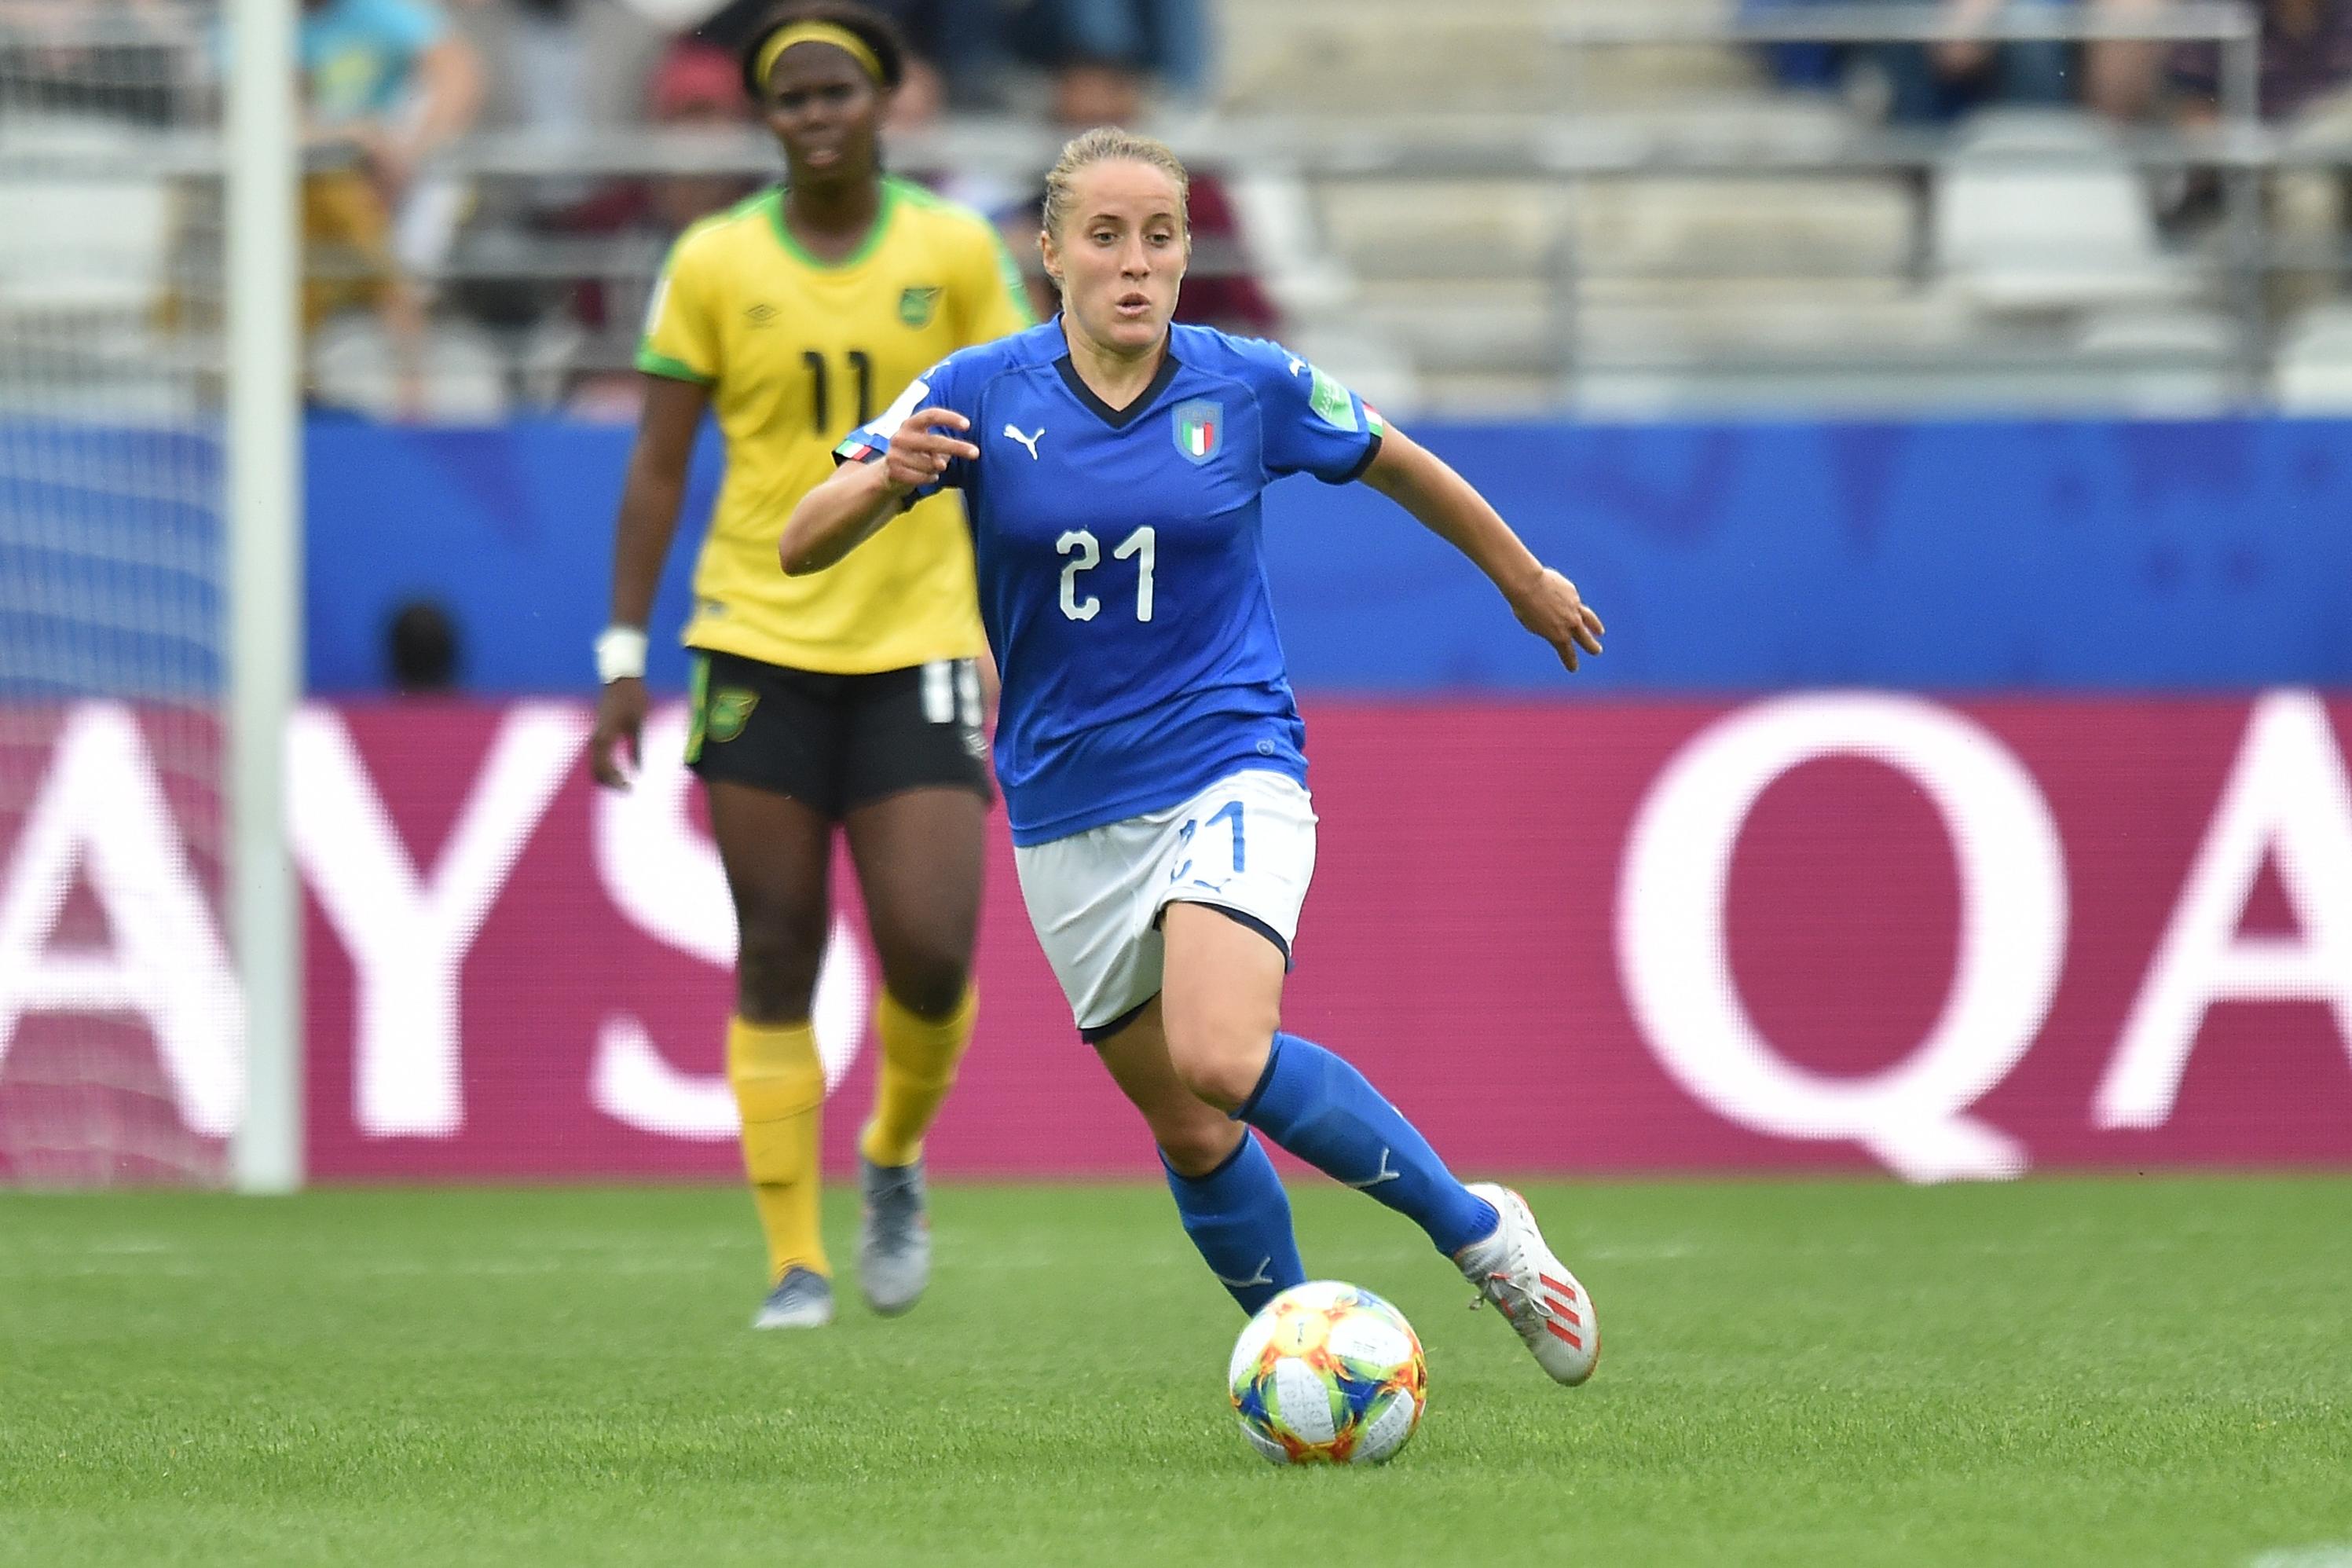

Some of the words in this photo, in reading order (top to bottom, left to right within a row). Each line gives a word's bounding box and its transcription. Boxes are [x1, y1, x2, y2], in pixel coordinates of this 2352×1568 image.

[801, 350, 872, 436] 11
[1056, 526, 1156, 622] 21
[1612, 686, 2352, 1185] QA
